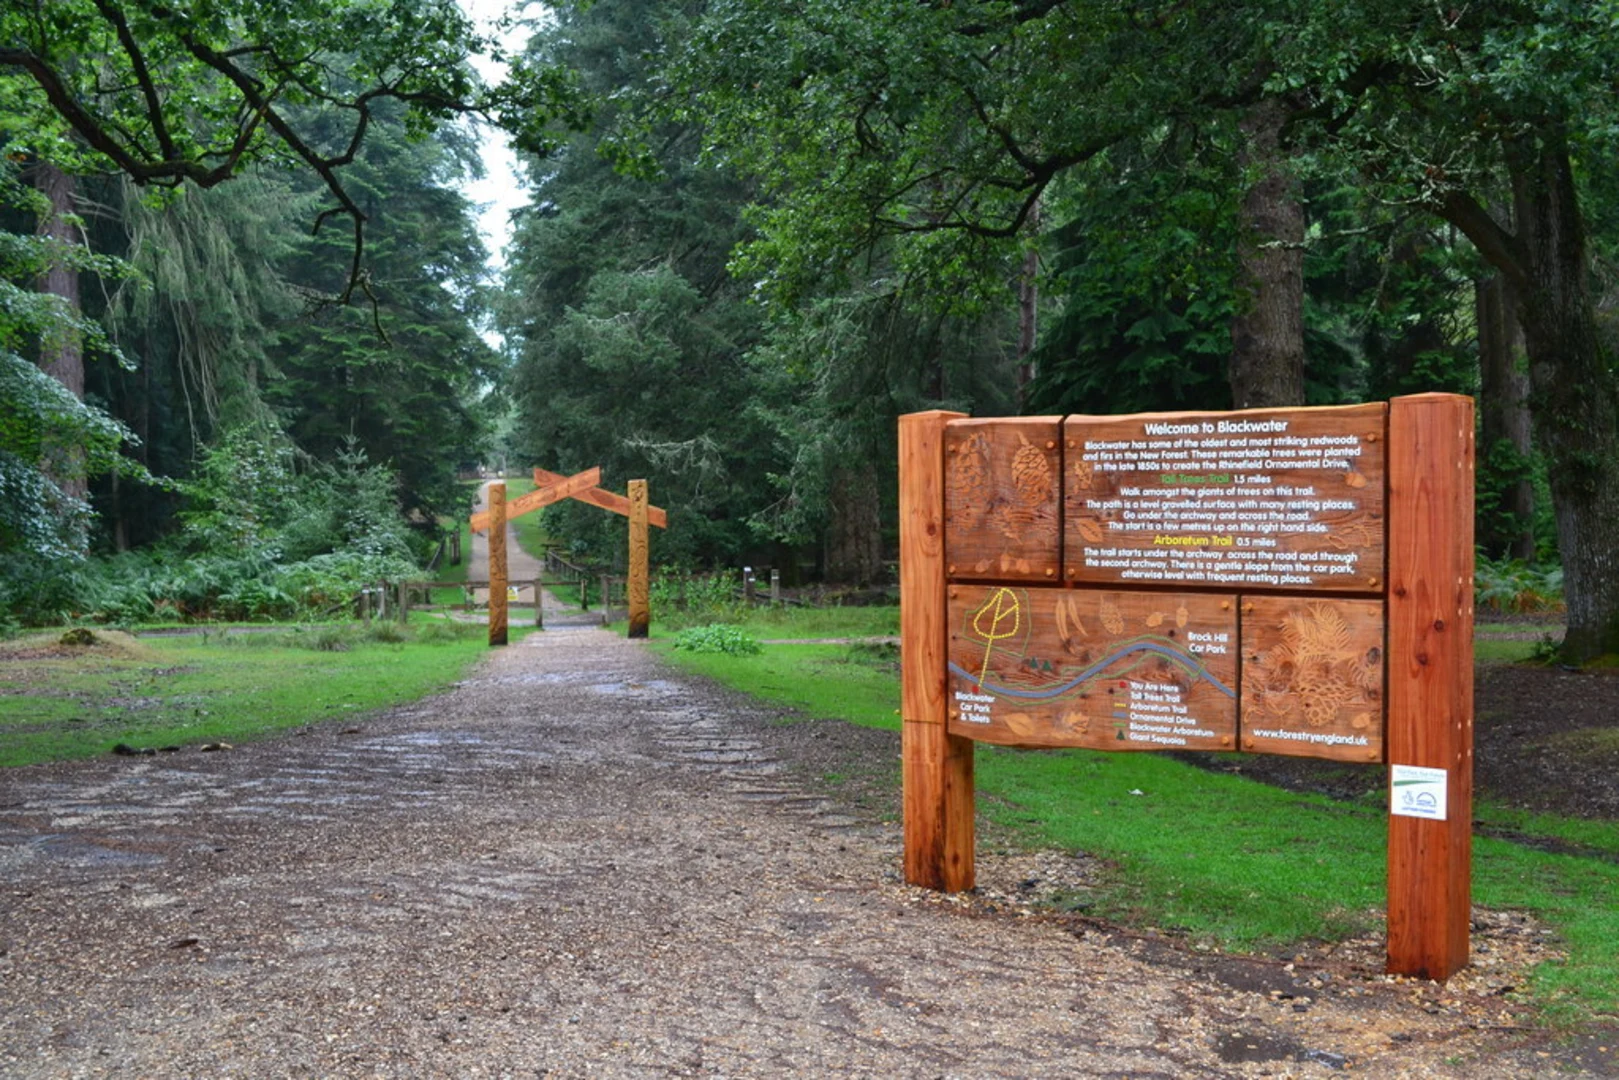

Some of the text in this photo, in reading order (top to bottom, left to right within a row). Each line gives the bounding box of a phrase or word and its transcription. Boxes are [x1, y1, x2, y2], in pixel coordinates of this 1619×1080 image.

[1144, 420, 1288, 436] Welcome to Blackwater
[1085, 441, 1130, 450] Blackwater
[1132, 440, 1146, 448] has
[1174, 438, 1183, 448] of
[1184, 439, 1198, 448] the
[1200, 438, 1228, 447] oldest
[1230, 438, 1246, 446] and
[1249, 438, 1272, 446] most
[1274, 436, 1308, 447] striking
[1310, 435, 1358, 444] redwoods
[1082, 452, 1098, 460] and
[1100, 451, 1113, 460] firs
[1115, 451, 1122, 460] in
[1124, 451, 1138, 460] the
[1140, 451, 1159, 460] New
[1191, 450, 1217, 458] These
[1219, 448, 1270, 458] remarkable
[1272, 448, 1296, 457] trees
[1324, 446, 1361, 457] planted
[1094, 462, 1102, 470] in
[1104, 462, 1117, 470] the
[1120, 462, 1135, 470] late
[1137, 462, 1160, 470] 1850s
[1162, 462, 1170, 470] to
[1172, 462, 1200, 470] create
[1202, 460, 1216, 470] the
[1218, 460, 1262, 469] Rhinefield
[1264, 459, 1320, 468] Ornamental
[1160, 474, 1271, 484] Tall Trees Trail 1.5 miles
[1120, 488, 1140, 496] Walk
[1142, 488, 1180, 498] amongst
[1181, 488, 1196, 496] the
[1198, 487, 1224, 498] giants
[1226, 487, 1235, 496] of
[1238, 488, 1260, 496] trees
[1276, 487, 1292, 496] this
[1087, 500, 1100, 508] The
[1102, 500, 1122, 510] path
[1124, 500, 1130, 508] is
[1141, 500, 1160, 508] level
[1162, 500, 1200, 510] gravelled
[1203, 500, 1236, 508] surface
[1238, 500, 1258, 508] with
[1260, 501, 1284, 510] many
[1288, 500, 1320, 510] resting
[1124, 510, 1136, 519] Go
[1138, 511, 1162, 519] under
[1164, 511, 1178, 519] the
[1180, 512, 1216, 522] archway
[1218, 512, 1236, 520] and
[1270, 512, 1284, 520] the
[1108, 522, 1124, 530] The
[1126, 522, 1146, 530] start
[1147, 522, 1154, 530] is
[1164, 522, 1179, 530] few
[1181, 522, 1211, 531] metres
[1214, 524, 1224, 532] up
[1240, 522, 1255, 531] the
[1258, 522, 1278, 533] right
[1280, 522, 1304, 532] hand
[1154, 535, 1276, 546] Arboretum Trail 0.5 miles
[1084, 548, 1098, 556] The
[1100, 548, 1116, 556] trail
[1118, 548, 1142, 556] starts
[1144, 548, 1168, 557] under
[1170, 549, 1184, 558] the
[1186, 549, 1224, 560] archway
[1258, 550, 1273, 559] the
[1276, 551, 1297, 560] road
[1300, 552, 1318, 560] and
[1320, 552, 1358, 563] through
[1086, 558, 1099, 566] the
[1100, 558, 1130, 567] second
[1171, 560, 1195, 568] There
[1197, 560, 1204, 569] is
[1214, 561, 1242, 571] gentle
[1244, 562, 1269, 572] slope
[1270, 562, 1293, 571] from
[1295, 563, 1310, 572] the
[1122, 570, 1162, 579] otherwise
[1164, 571, 1184, 580] level
[1186, 572, 1204, 580] with
[1206, 572, 1244, 582] frequent
[1246, 574, 1278, 584] resting
[1188, 632, 1228, 642] Brock Hill
[1189, 643, 1226, 654] Car Park
[1130, 681, 1179, 692] You Are Here
[955, 692, 996, 702] Blackwater
[1144, 693, 1163, 702] Trees
[1165, 694, 1180, 702] Trail
[960, 702, 990, 712] Car Park
[1130, 702, 1188, 714] Arboretum Trail
[969, 713, 990, 724] Toilets
[1130, 712, 1196, 725] Ornamental Drive
[1130, 722, 1214, 737] Blackwater Arboretum
[1130, 732, 1187, 745] Giant Sequoias
[1253, 729, 1368, 745] www.forestryengland.uk
